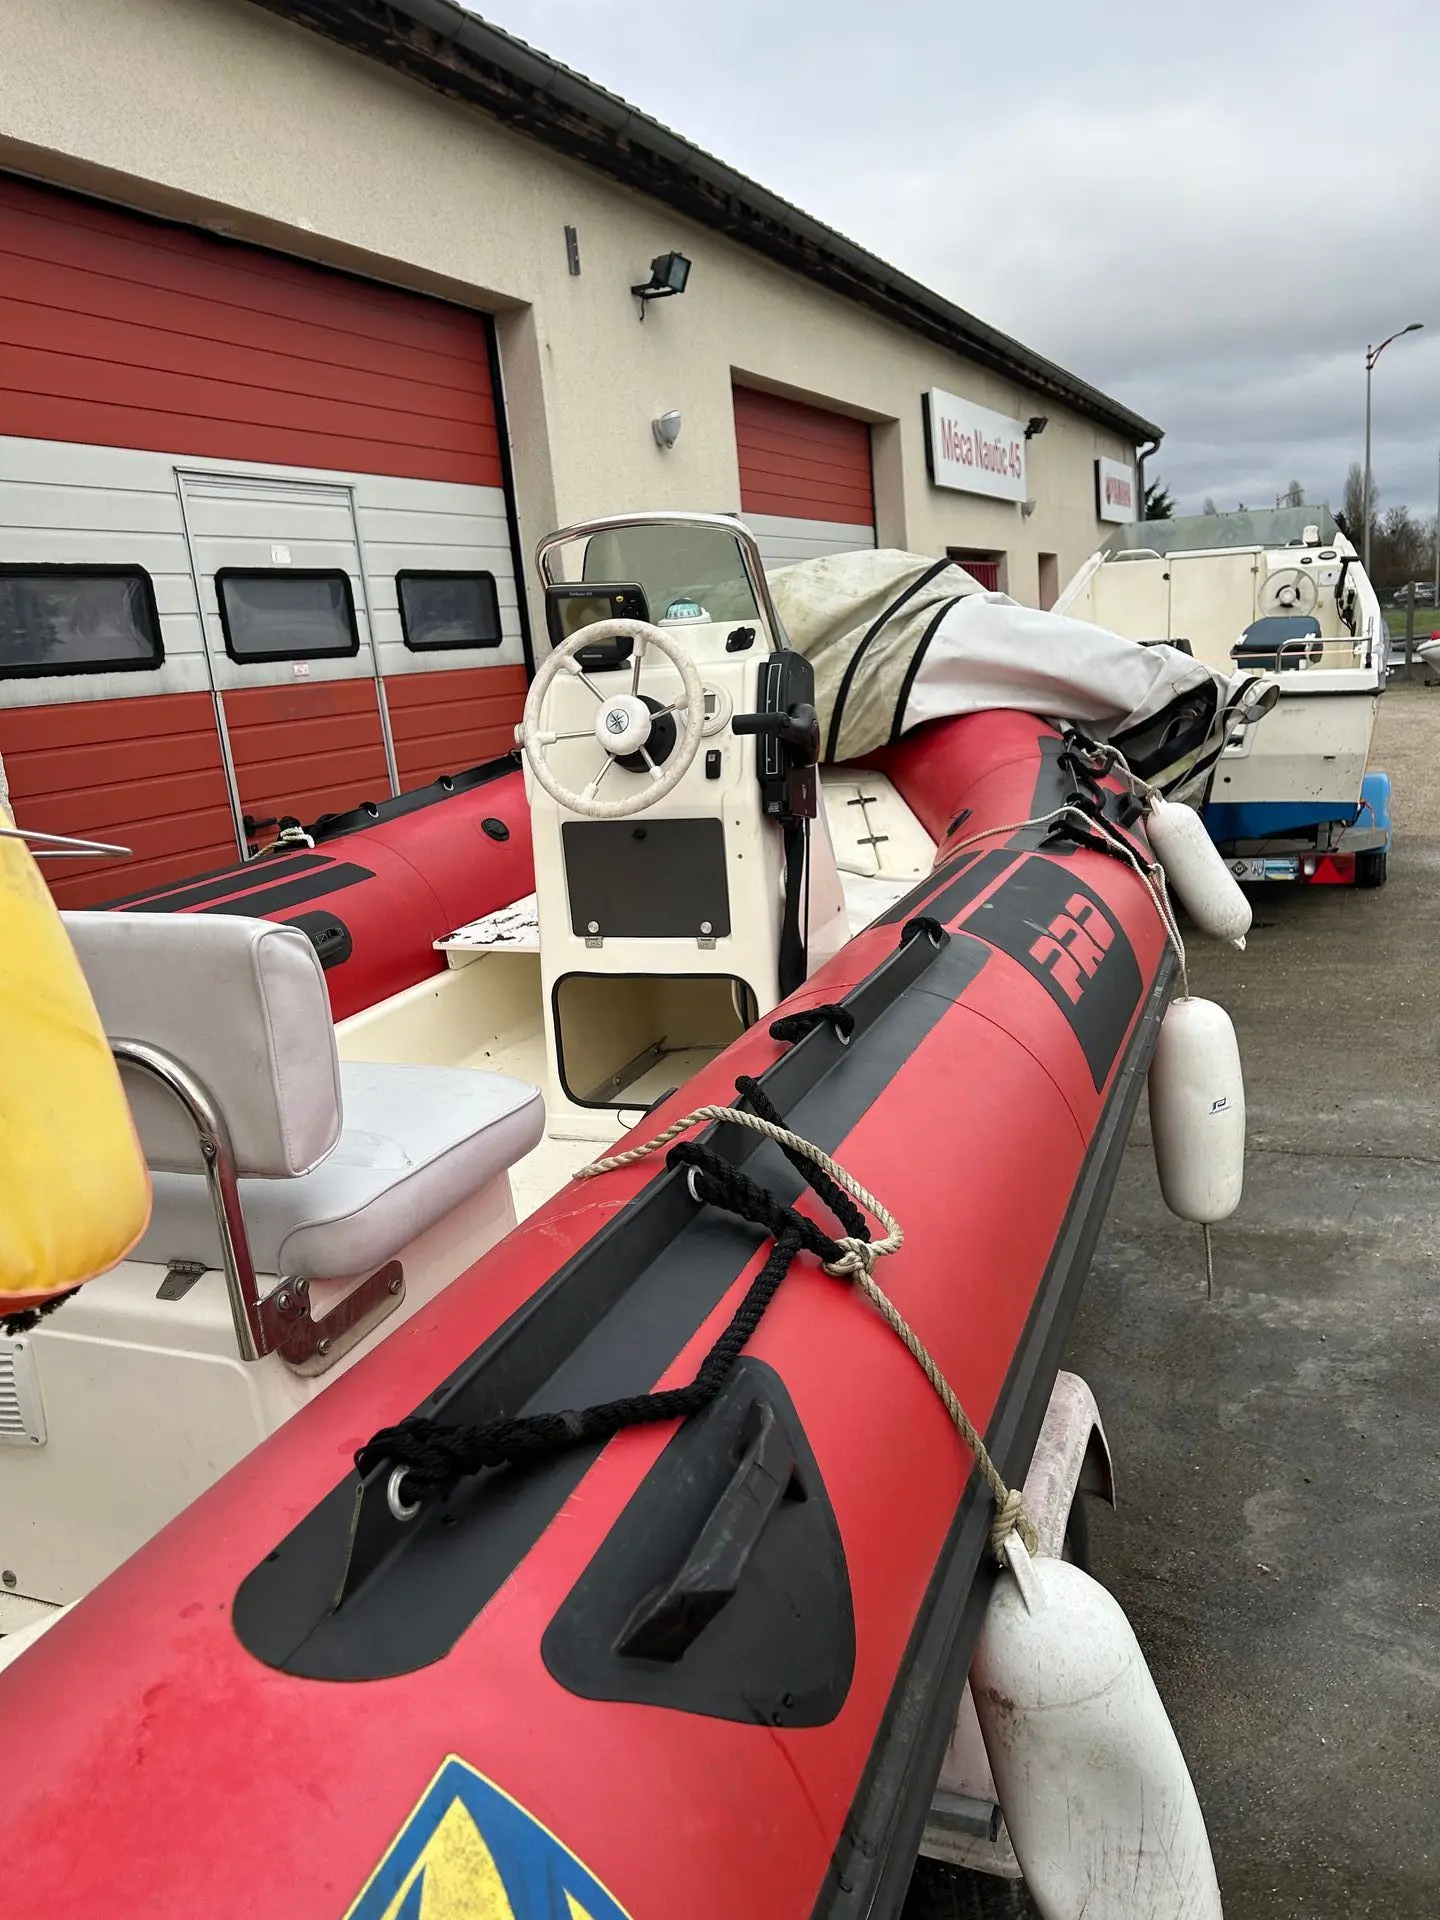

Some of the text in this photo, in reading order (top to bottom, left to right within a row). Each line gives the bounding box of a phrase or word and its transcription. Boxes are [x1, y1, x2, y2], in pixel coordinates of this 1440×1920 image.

[941, 417, 1021, 479] Méca Nautic 45
